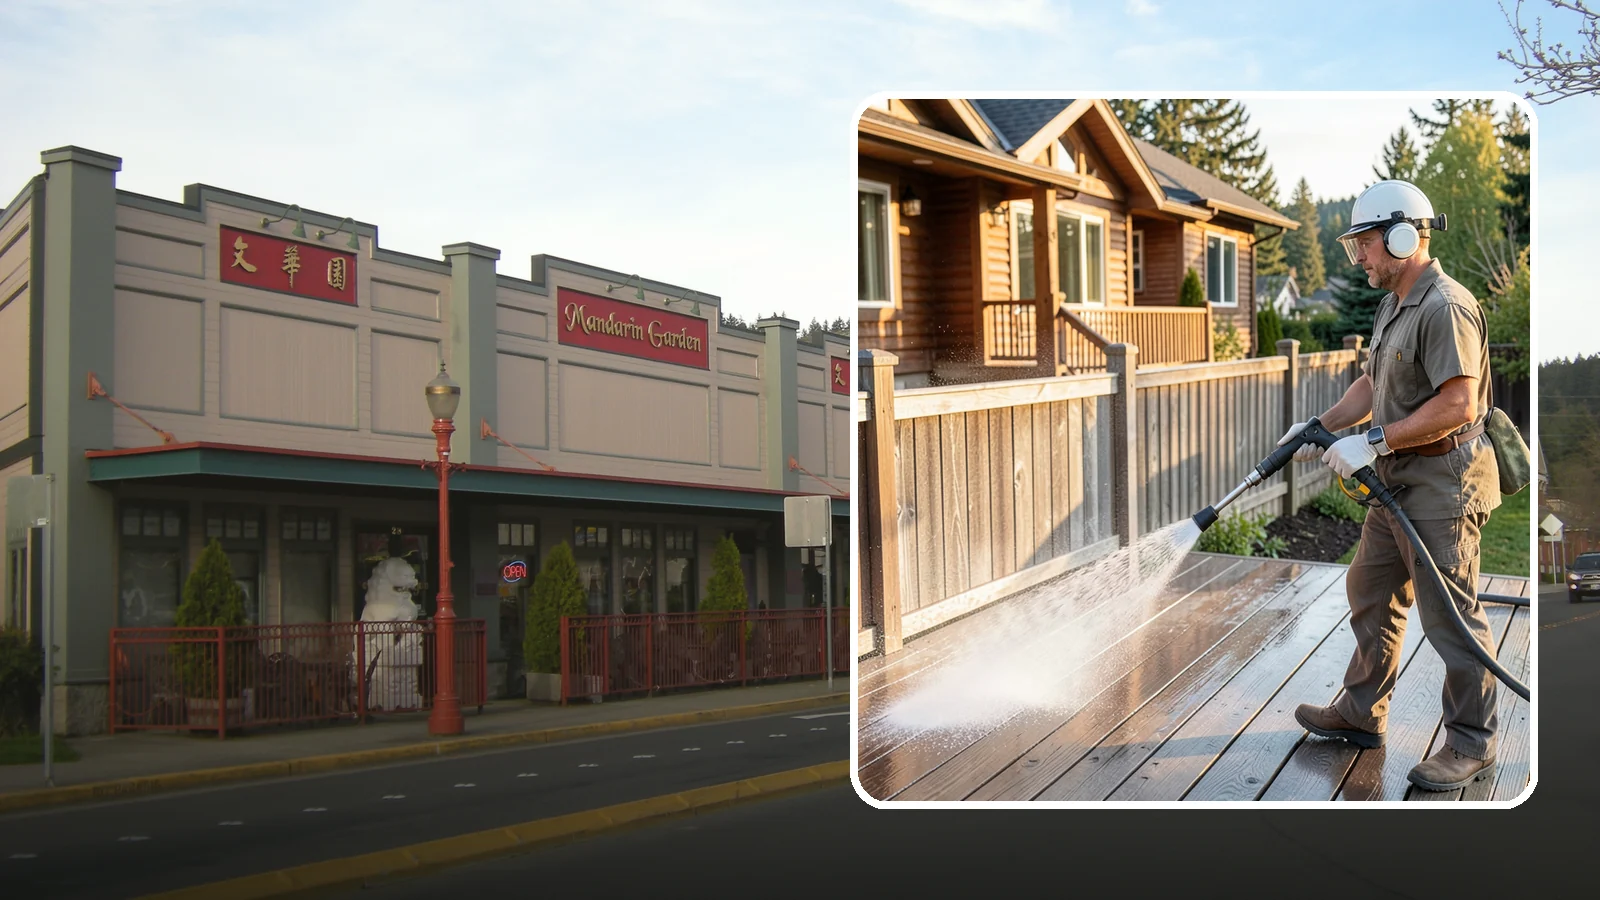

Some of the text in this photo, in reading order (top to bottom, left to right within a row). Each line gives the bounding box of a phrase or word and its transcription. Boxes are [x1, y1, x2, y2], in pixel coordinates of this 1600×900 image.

[231, 236, 346, 290] 文華園
[564, 302, 701, 352] Mandarin Garden
[503, 565, 527, 578] OPEN
